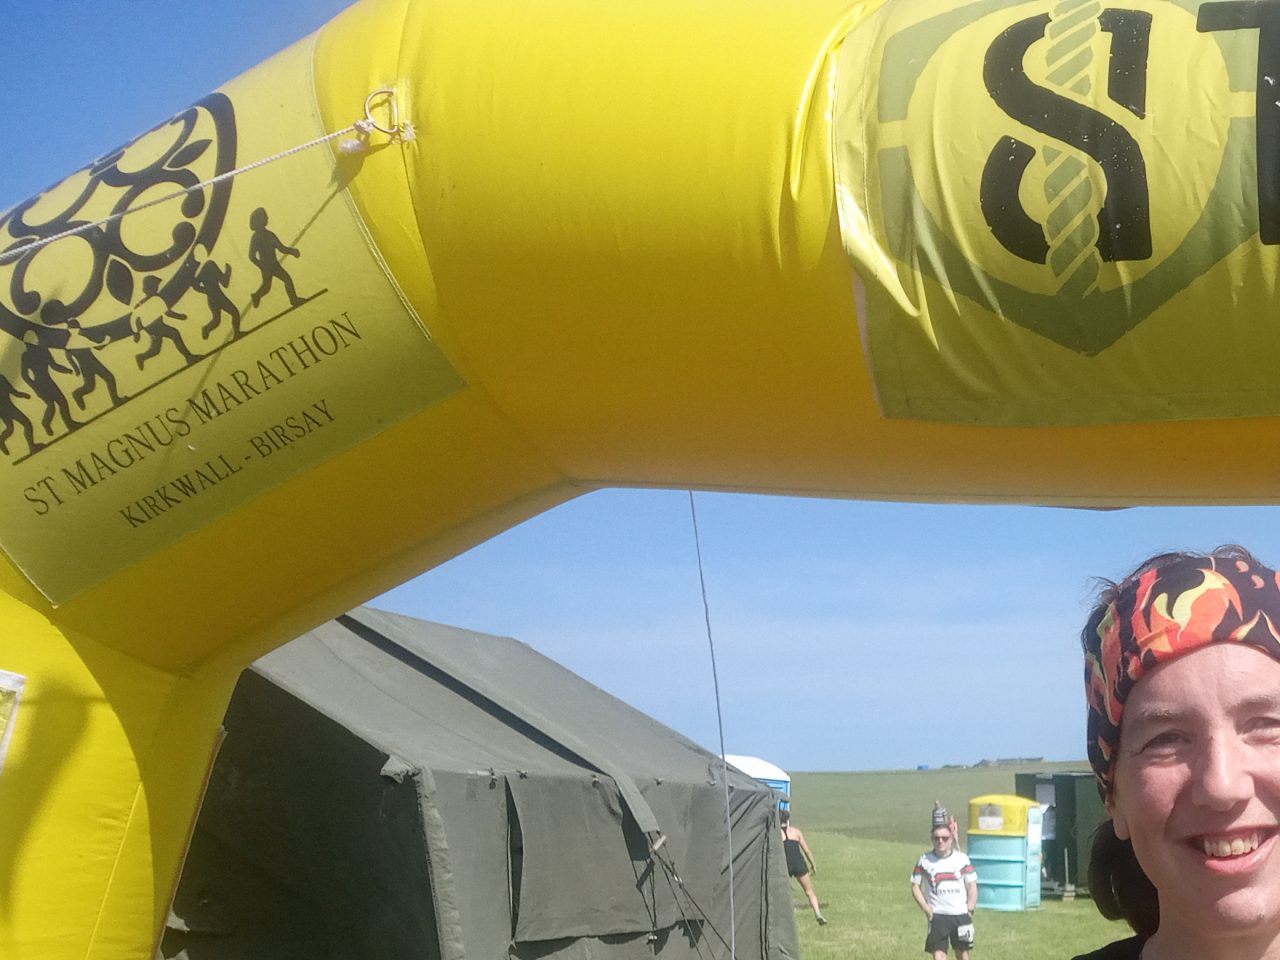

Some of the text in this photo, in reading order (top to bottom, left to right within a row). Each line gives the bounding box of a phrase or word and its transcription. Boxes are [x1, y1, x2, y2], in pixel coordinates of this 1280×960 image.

[23, 312, 363, 516] ST MAGNUS MARATHON
[119, 455, 243, 529] KIRKWALL
[250, 398, 336, 460] BIRSAY
